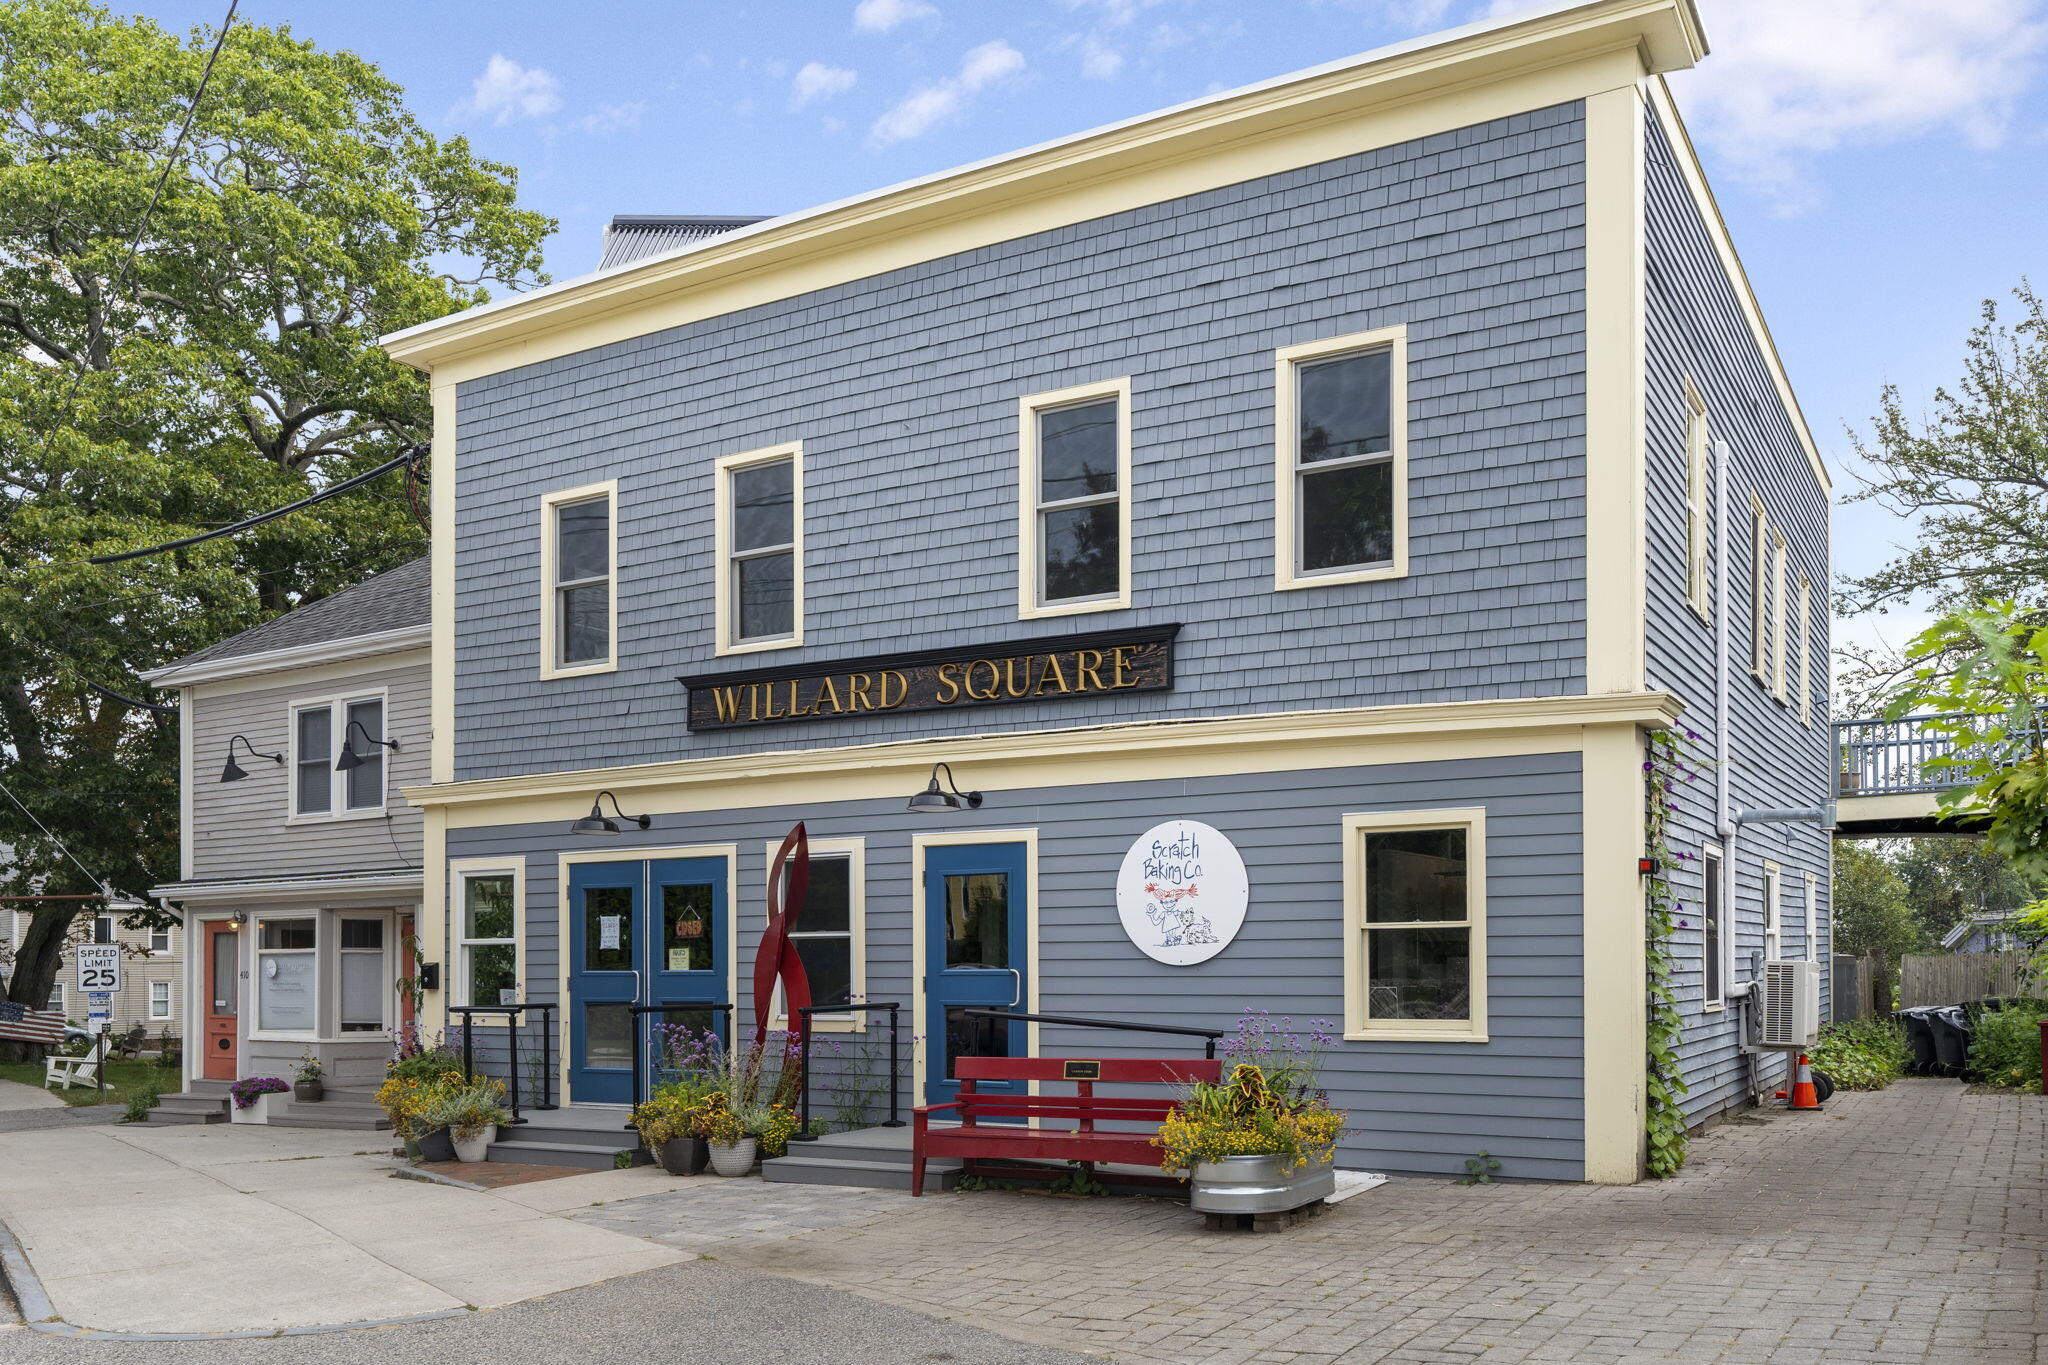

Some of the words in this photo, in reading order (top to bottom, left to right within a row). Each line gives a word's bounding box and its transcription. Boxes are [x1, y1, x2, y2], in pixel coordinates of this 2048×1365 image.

[711, 670, 908, 723] WILLARD
[936, 645, 1140, 703] SQUARE
[1152, 830, 1200, 861] Scratch
[1143, 857, 1182, 885] Baking
[1183, 860, 1204, 880] Co.
[80, 949, 117, 958] SPEED
[84, 959, 113, 968] LIMIT
[82, 969, 116, 987] 25
[240, 970, 250, 980] 410
